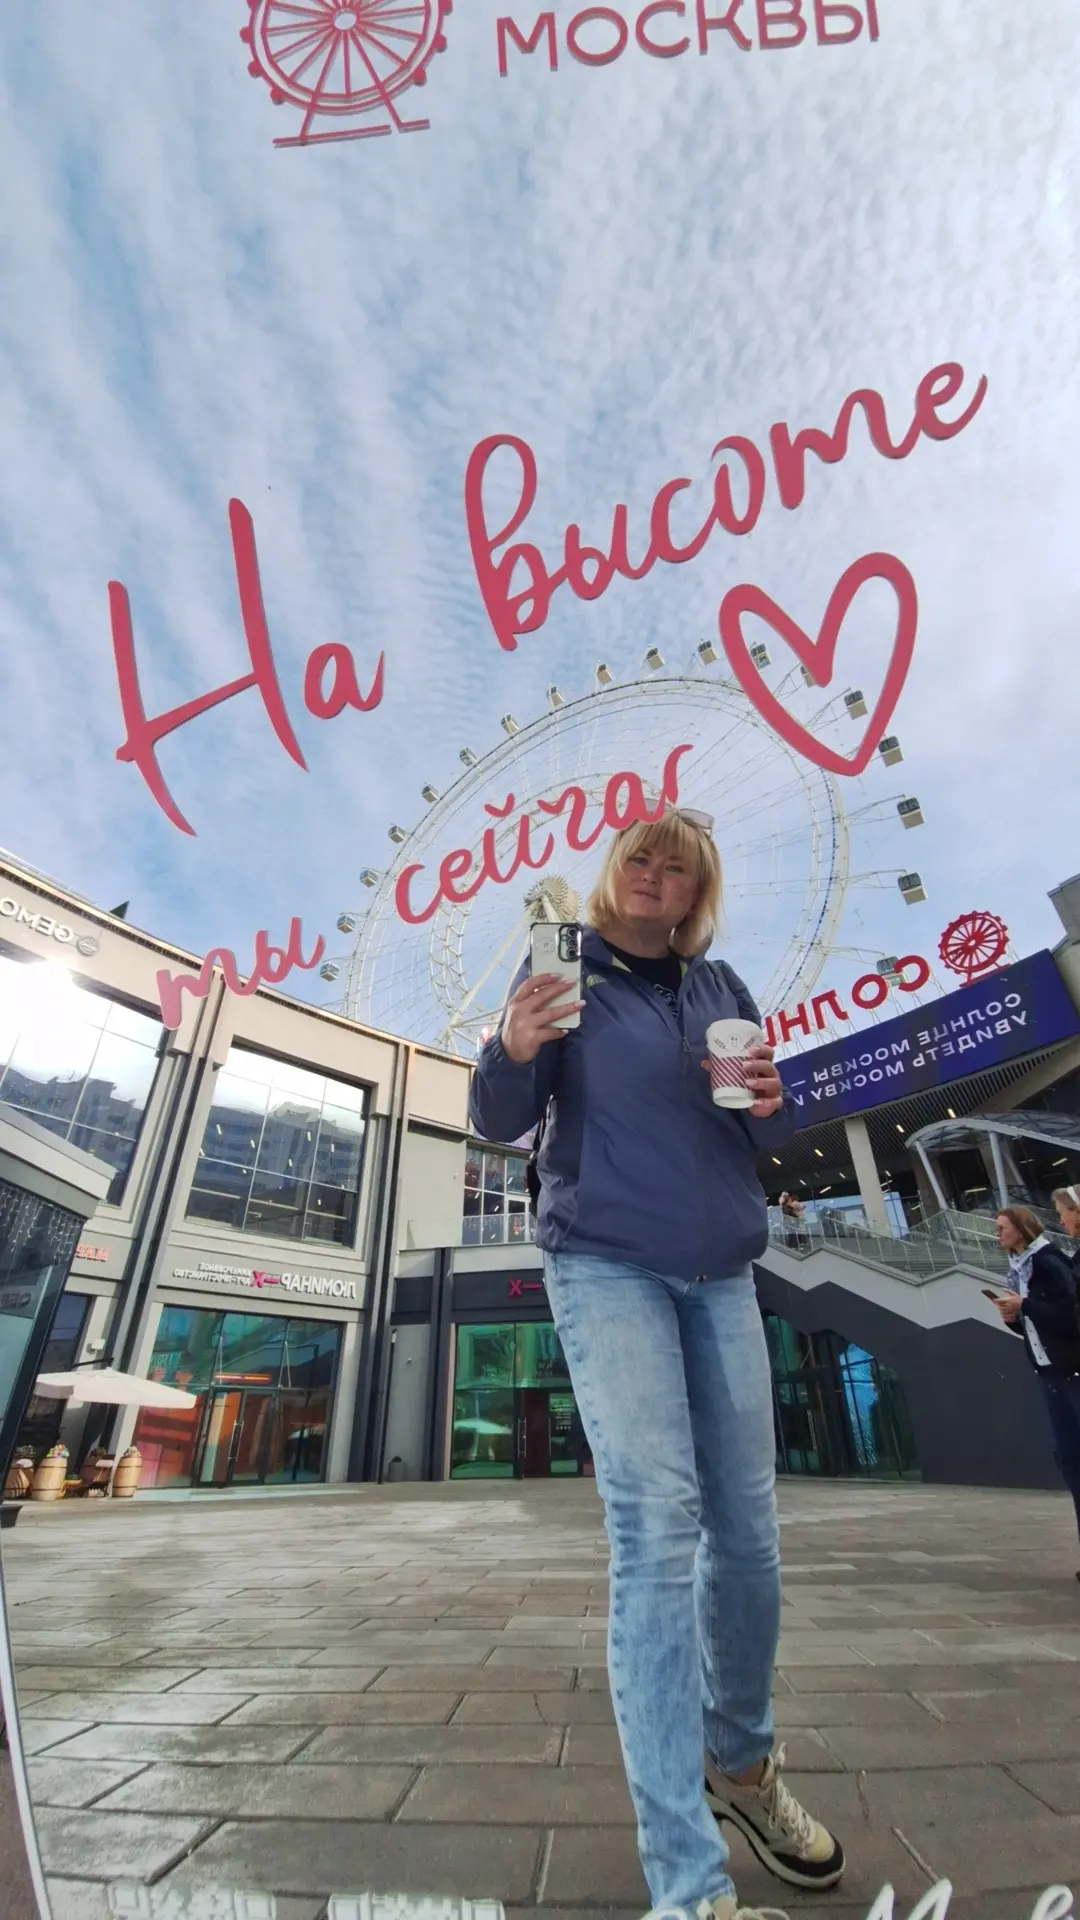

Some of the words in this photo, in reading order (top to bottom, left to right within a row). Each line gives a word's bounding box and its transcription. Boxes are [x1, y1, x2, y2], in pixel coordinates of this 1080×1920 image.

[497, 0, 880, 77] МОСКВЫ
[108, 498, 385, 838] На
[464, 362, 988, 652] высоте
